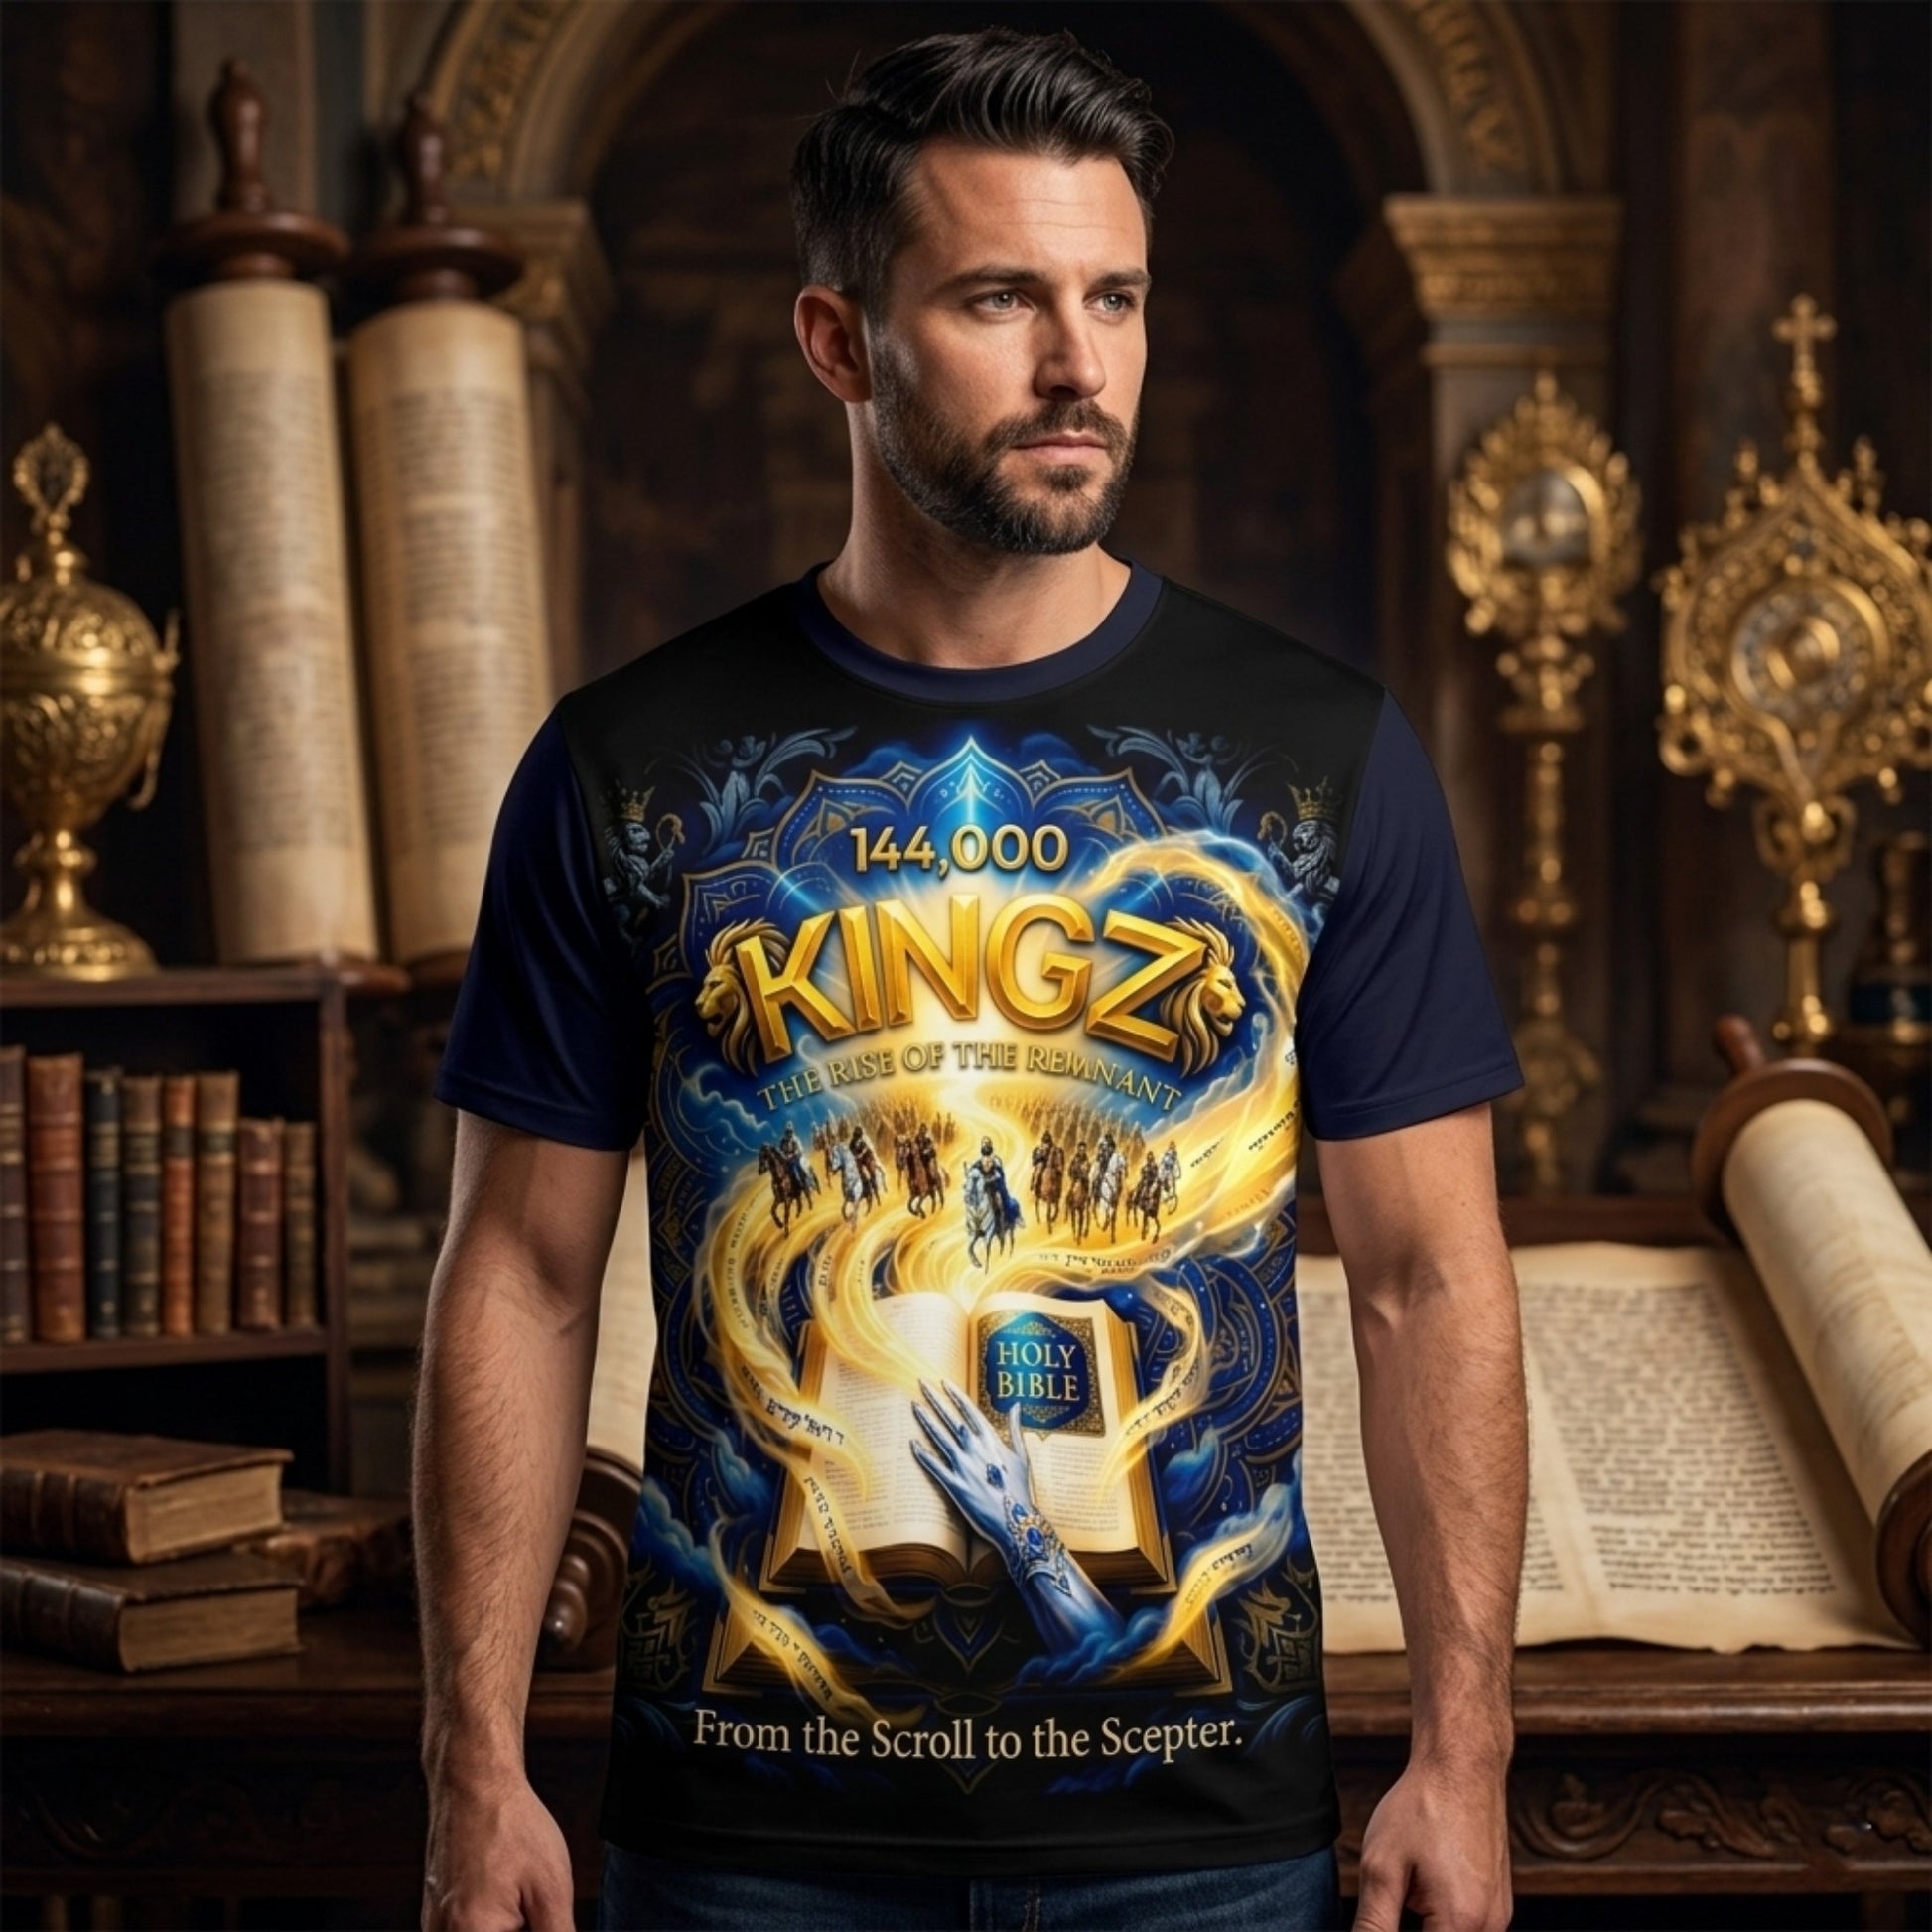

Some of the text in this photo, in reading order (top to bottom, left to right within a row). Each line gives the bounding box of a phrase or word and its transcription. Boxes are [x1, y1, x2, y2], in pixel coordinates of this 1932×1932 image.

[850, 823, 1069, 879] 144,000
[736, 894, 1207, 1063] KINGZ
[757, 1041, 1182, 1111] THE RISE OF THE REMNANT
[996, 1341, 1076, 1369] HOLY
[996, 1371, 1080, 1402] BIBLE
[693, 1708, 1243, 1765] From the Scroll to the Scepter.
